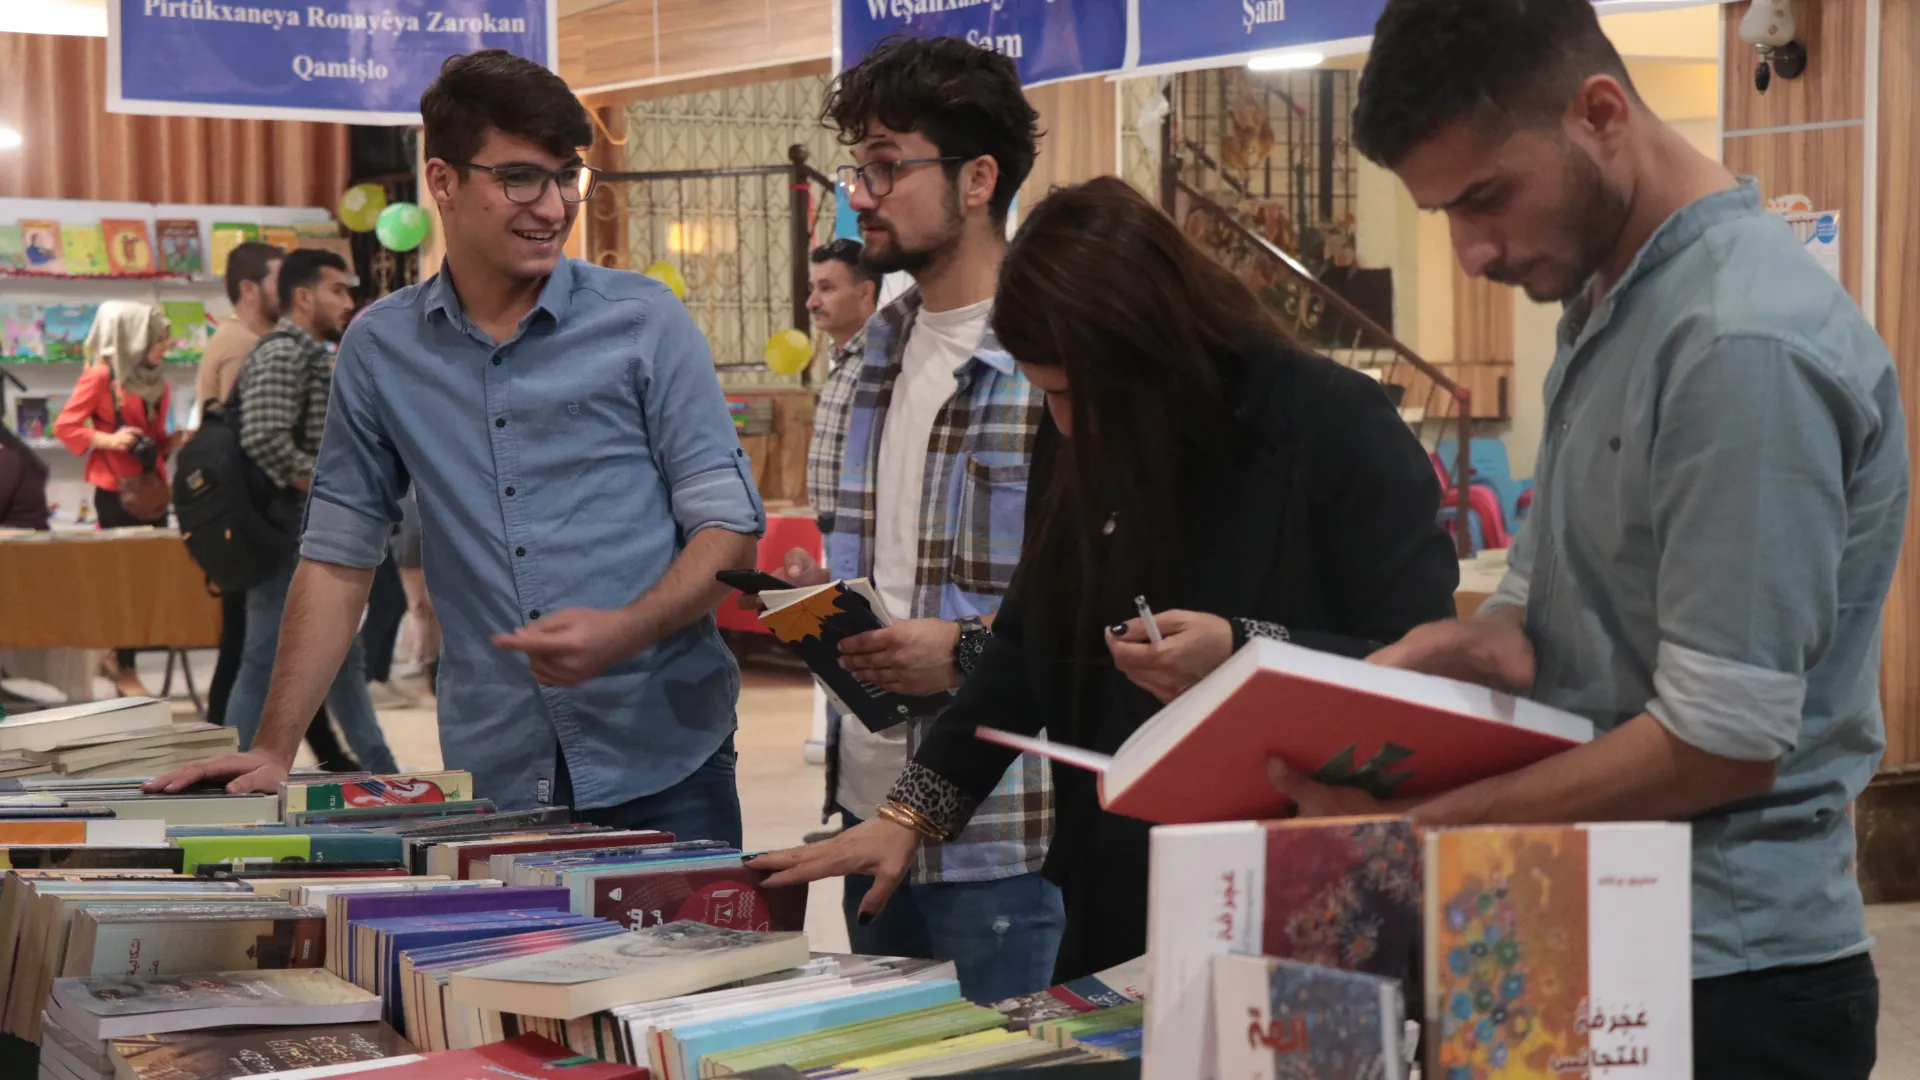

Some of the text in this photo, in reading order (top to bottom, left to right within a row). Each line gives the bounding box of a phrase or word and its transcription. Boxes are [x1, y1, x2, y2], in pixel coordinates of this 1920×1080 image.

[307, 6, 420, 36] Ronayêya
[426, 11, 525, 33] Zarokan
[1242, 0, 1285, 34] Şam
[292, 55, 388, 83] Qamişlo
